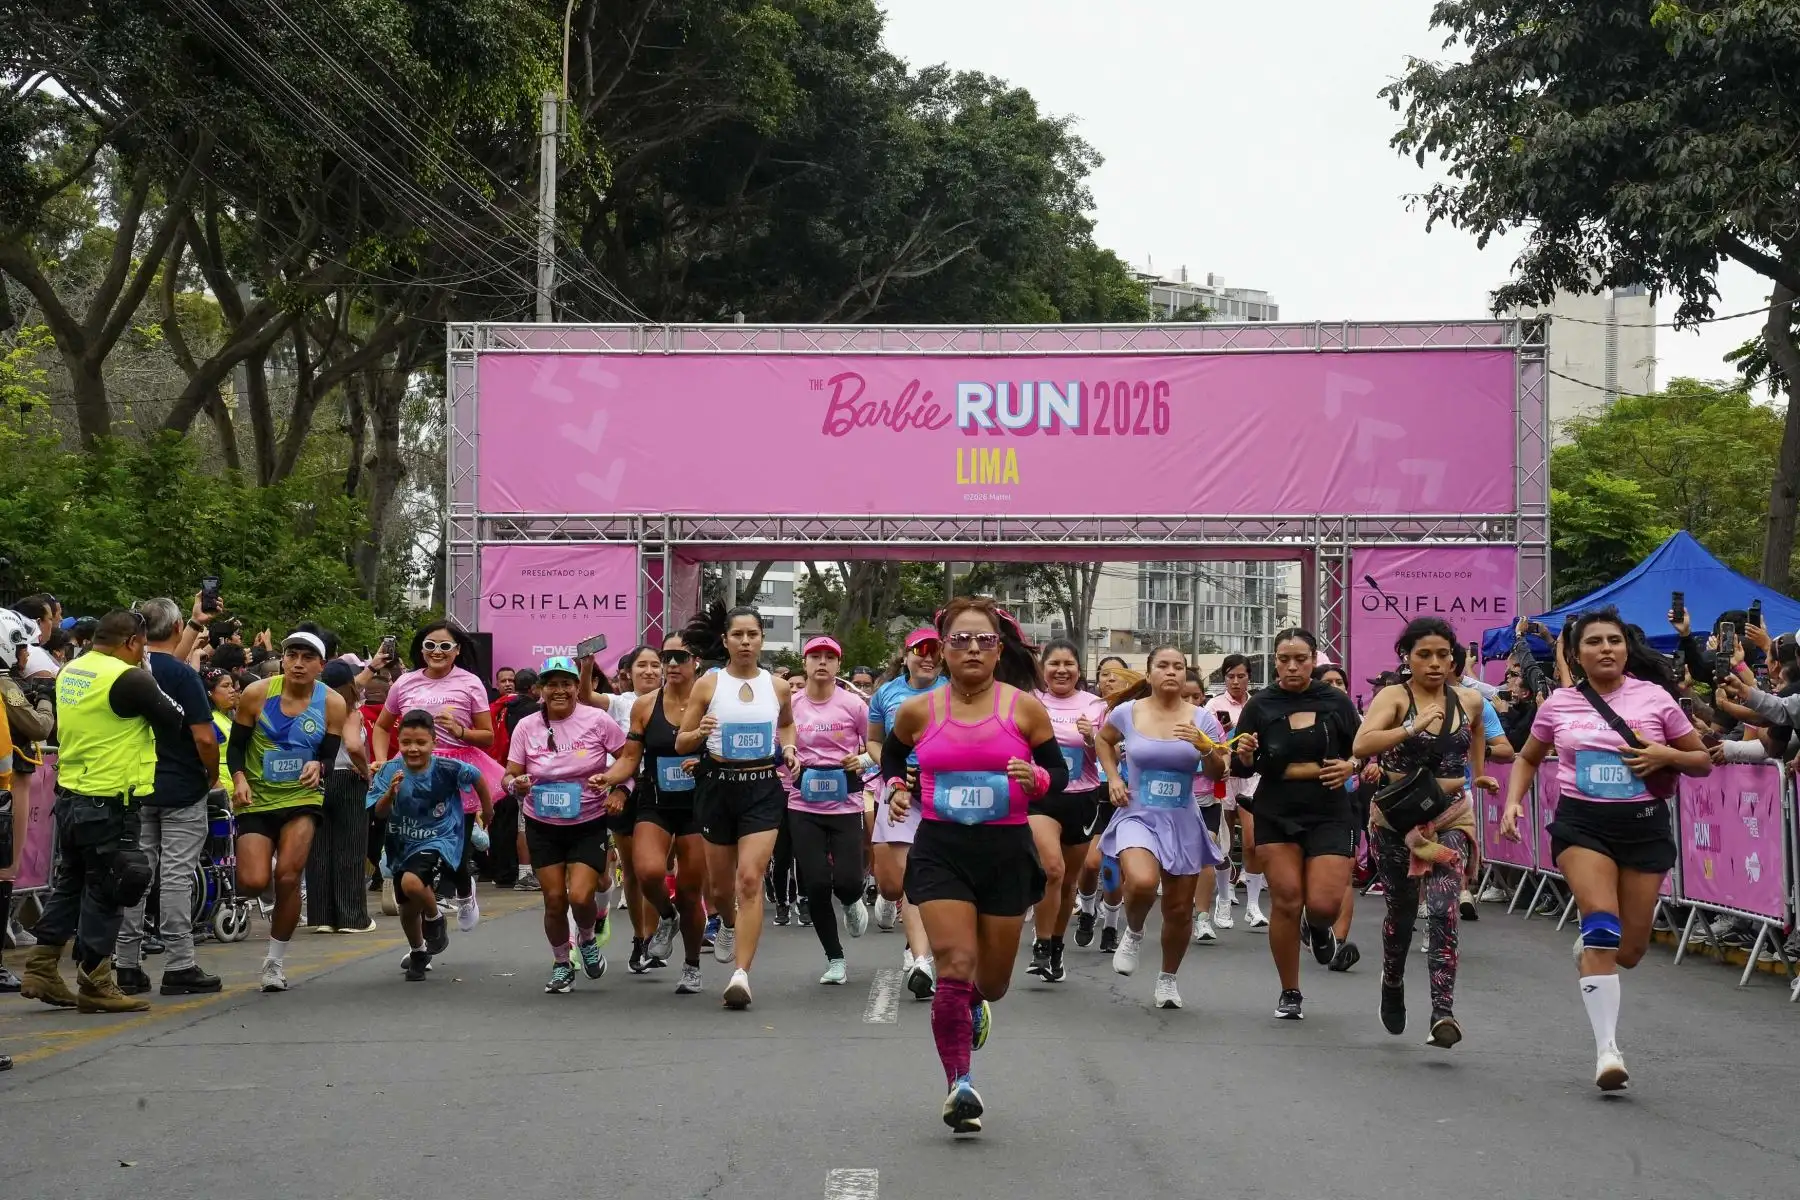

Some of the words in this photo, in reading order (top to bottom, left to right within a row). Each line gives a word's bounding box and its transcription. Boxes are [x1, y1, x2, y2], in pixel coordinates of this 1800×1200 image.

[809, 379, 824, 391] THE
[821, 371, 953, 437] Barbie
[956, 380, 1089, 437] RUN
[1093, 380, 1171, 437] 2026
[956, 447, 1020, 485] LIMA
[521, 569, 575, 577] PRESENTADO
[578, 569, 595, 577] POR
[1395, 571, 1452, 579] PRESENTADO
[1454, 571, 1473, 579] POR
[489, 592, 627, 610] ORIFLAME
[1361, 594, 1507, 613] ORIFLAME
[531, 645, 579, 657] POWE
[815, 723, 833, 733] RUN
[737, 734, 760, 747] 2654
[278, 760, 299, 771] 2254
[1599, 766, 1624, 782] 1075
[817, 780, 831, 792] 108
[1158, 782, 1175, 796] 323
[547, 793, 565, 806] 1095
[961, 788, 981, 807] 241
[402, 815, 420, 828] Fly
[1694, 822, 1711, 850] RUN
